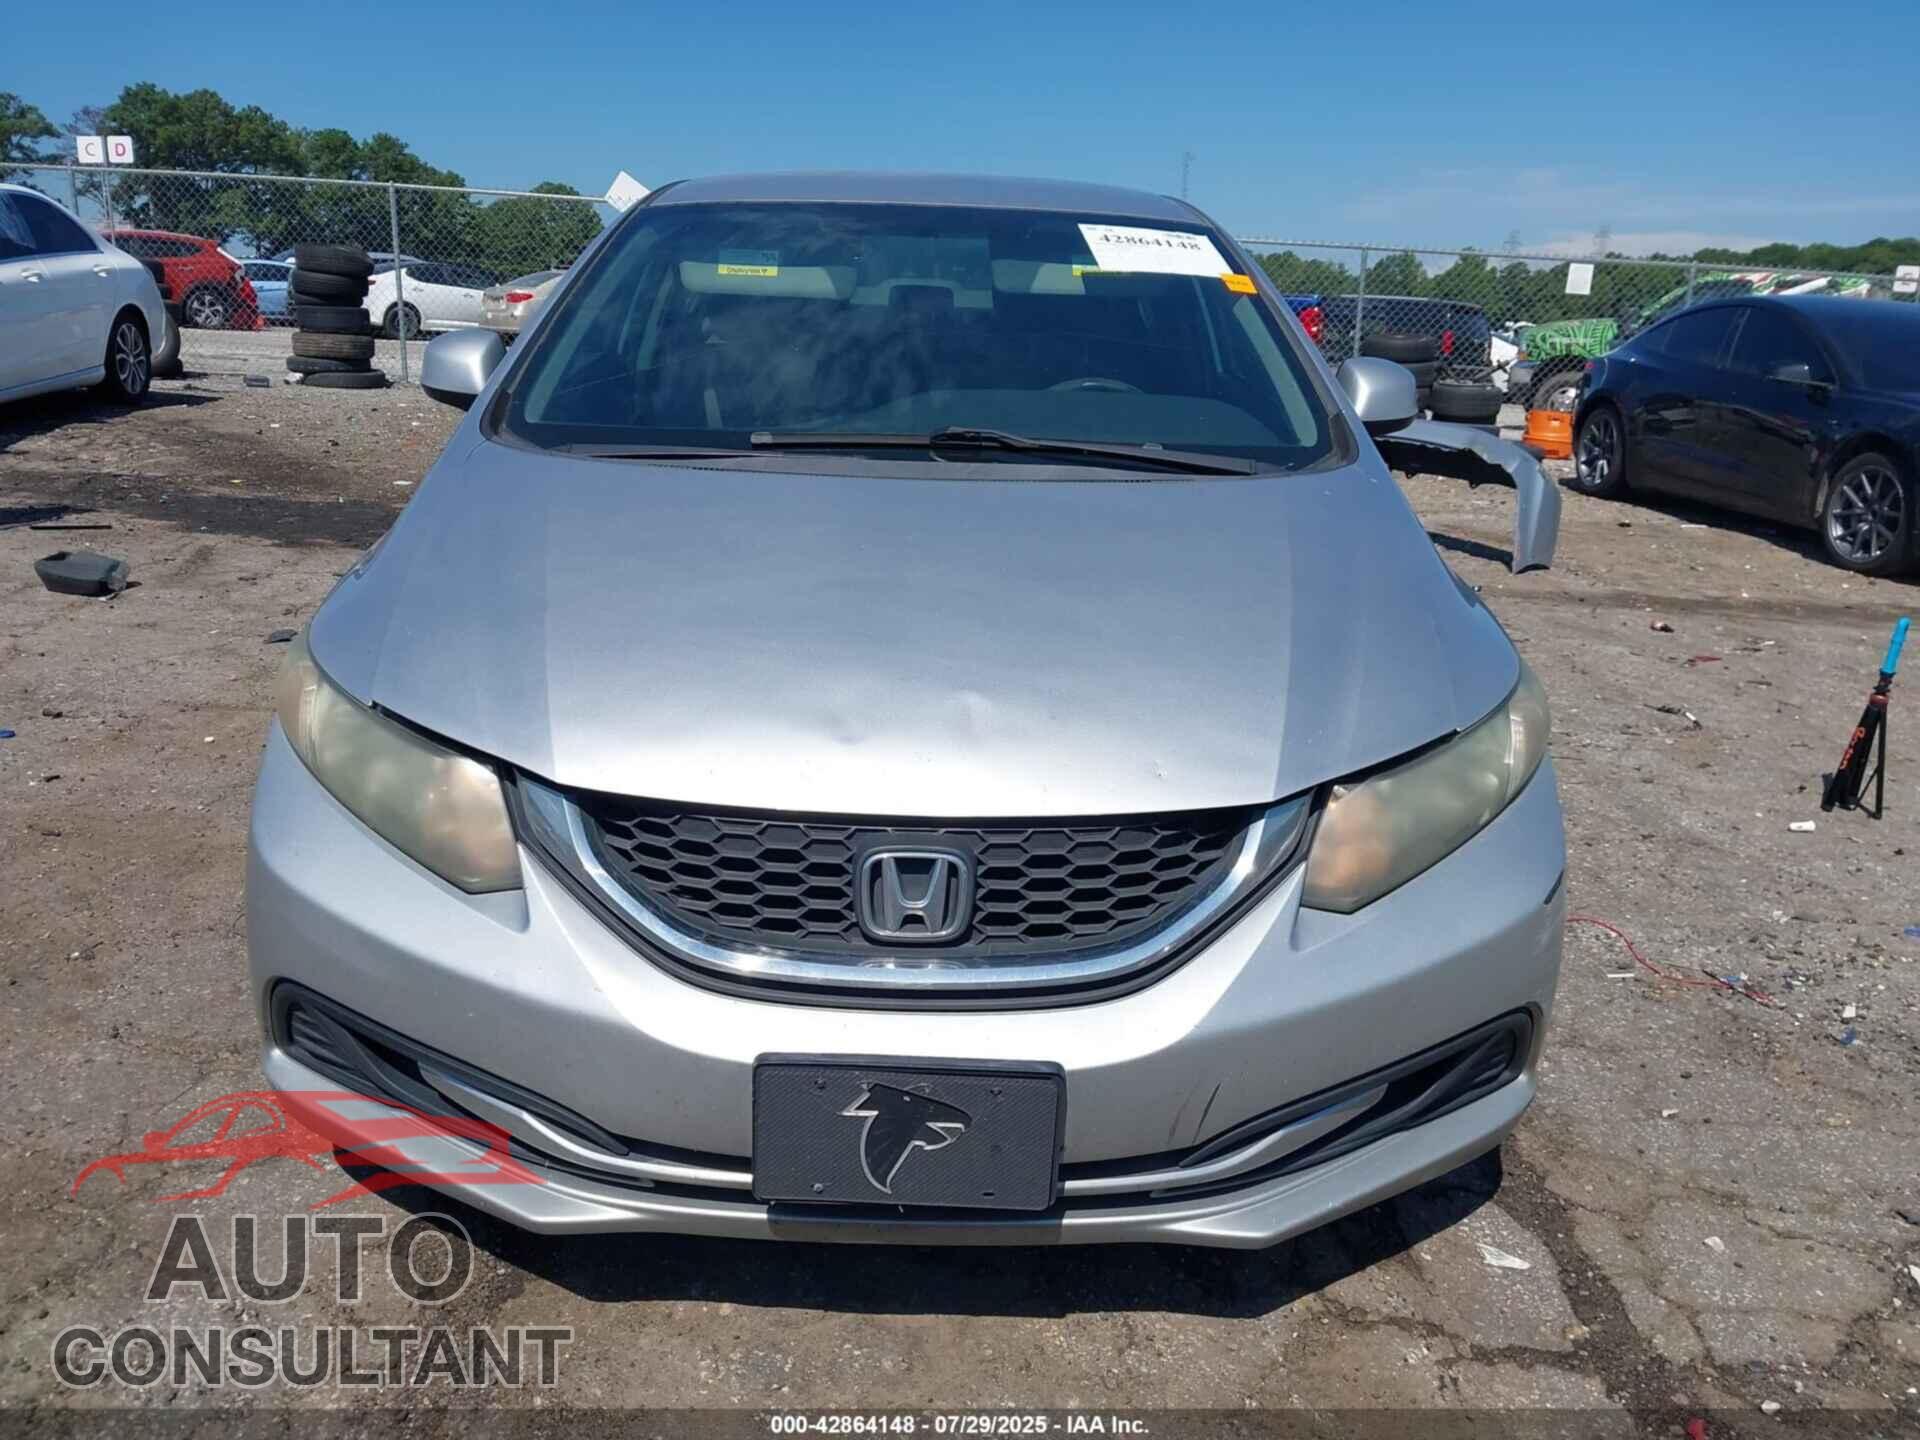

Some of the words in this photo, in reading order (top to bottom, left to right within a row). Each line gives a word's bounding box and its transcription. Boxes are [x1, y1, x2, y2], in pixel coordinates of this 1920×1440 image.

[85, 143, 96, 156] C
[115, 143, 126, 157] D
[1100, 234, 1201, 250] 42864148
